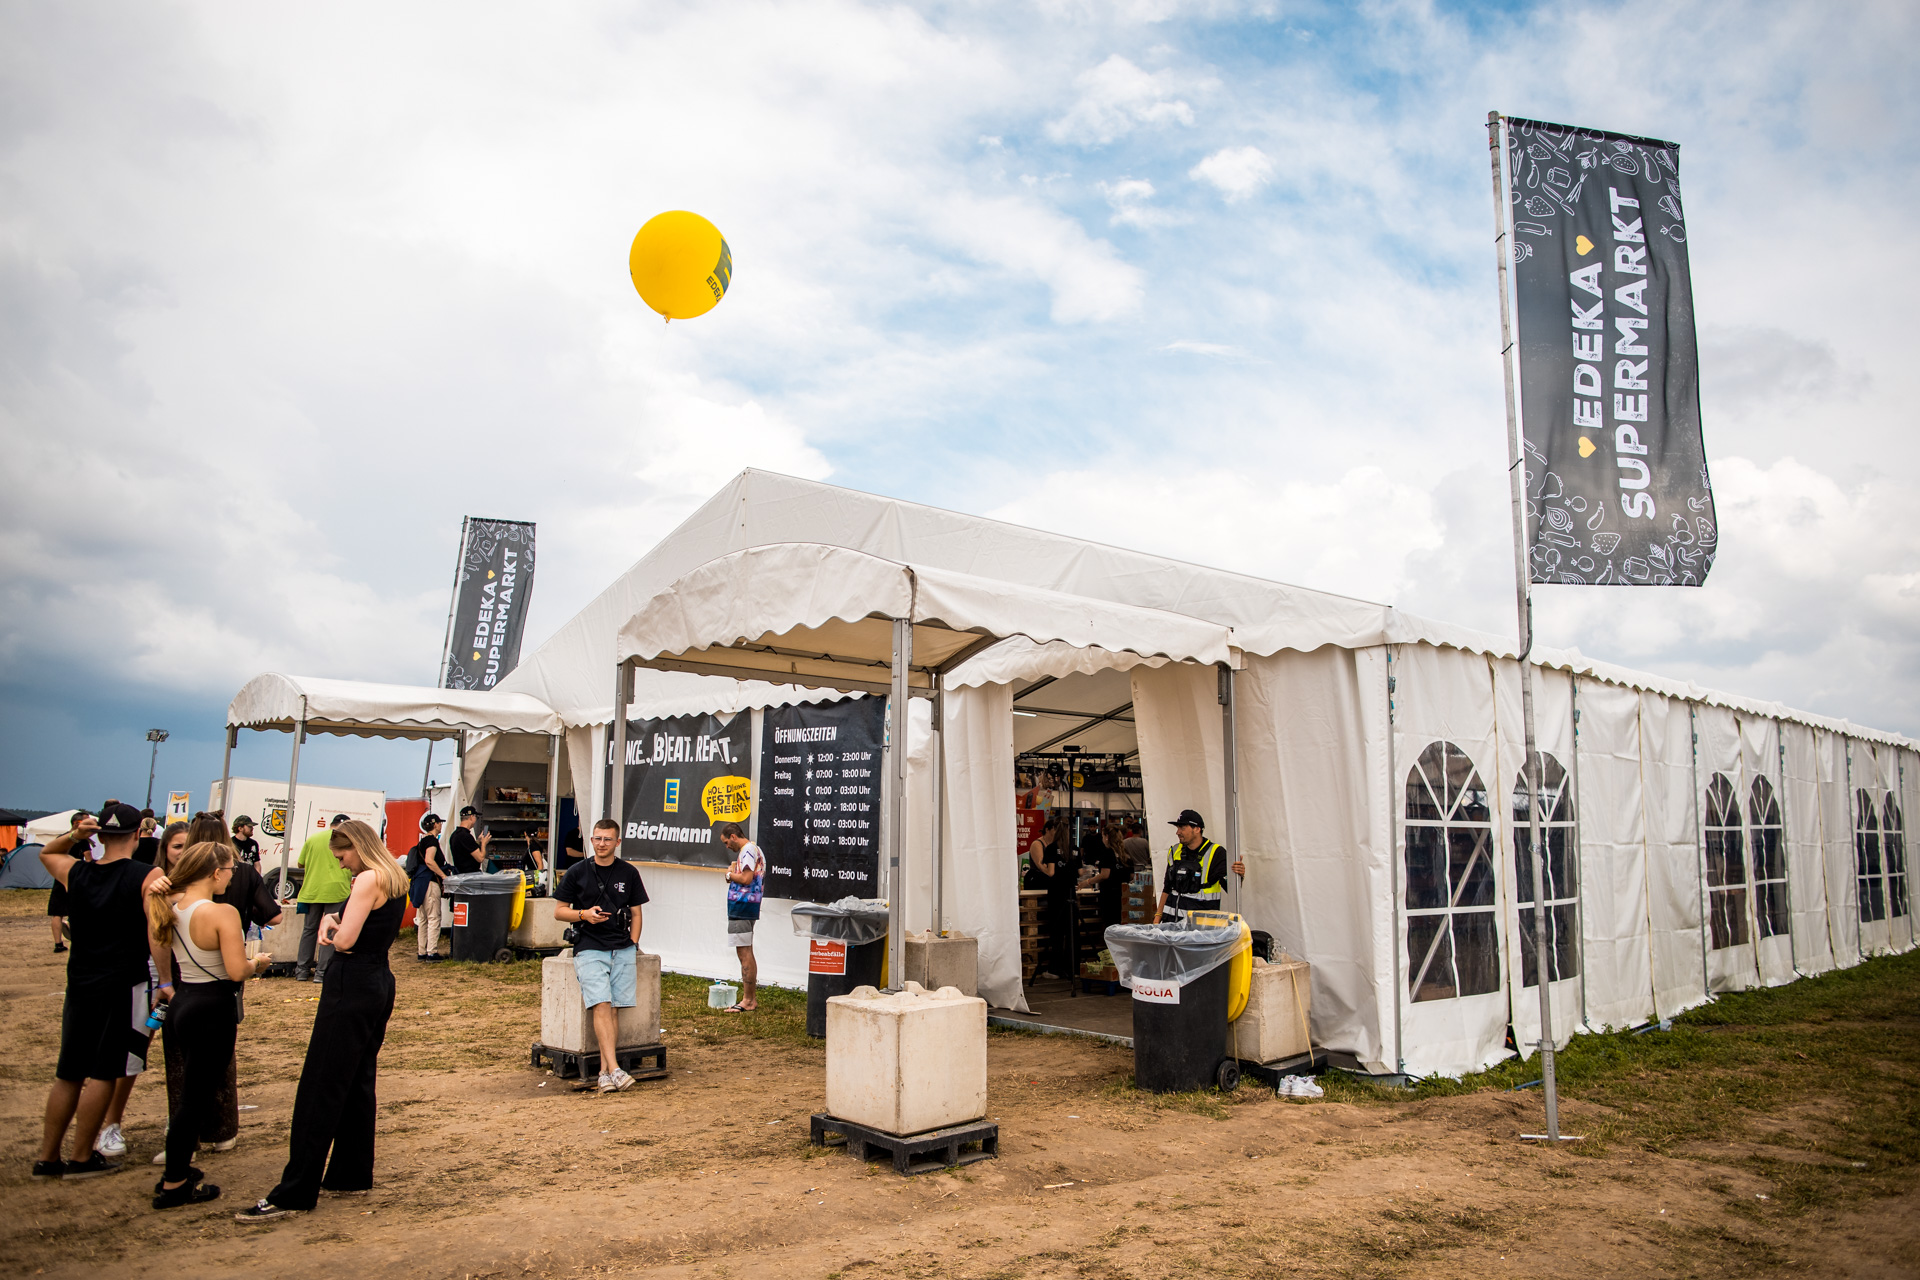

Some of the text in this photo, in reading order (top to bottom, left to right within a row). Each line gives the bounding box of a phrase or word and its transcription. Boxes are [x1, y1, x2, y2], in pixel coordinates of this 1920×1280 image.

[706, 275, 722, 303] EDEK
[1570, 262, 1604, 429] EDEKA
[1609, 186, 1656, 520] SUPERMARKT
[473, 581, 498, 649] EDEKA
[484, 548, 518, 687] SUPERMARKT
[774, 726, 837, 743] ÖFFNUNGSZEITEN
[774, 755, 801, 764] Donnerstag
[817, 753, 834, 762] 12:00
[842, 752, 860, 761] 23:00
[860, 751, 872, 761] Uhr
[774, 771, 792, 781] Freitag
[815, 769, 833, 778] 07:00
[841, 769, 859, 778] 18:00
[859, 768, 871, 778] Uhr
[706, 790, 750, 807] FESTIAL
[774, 786, 794, 796] Samstag
[815, 786, 832, 795] 01:00
[840, 786, 857, 795] 03:00
[858, 786, 871, 795] Uhr
[813, 802, 831, 812] 07:00
[840, 802, 857, 812] 18:00
[858, 802, 870, 812] Uhr
[773, 818, 794, 829] Sonntag
[813, 819, 831, 828] 01:00
[837, 819, 857, 828] 03:00
[858, 819, 870, 829] Uhr
[625, 821, 712, 843] Bächmann
[274, 842, 294, 855] Tor
[812, 835, 830, 845] 07:00
[838, 836, 857, 846] 18:00
[857, 837, 870, 847] Uhr
[771, 865, 792, 877] Montag
[811, 868, 829, 878] 07:00
[838, 870, 855, 880] 12:00
[856, 871, 869, 881] Uhr
